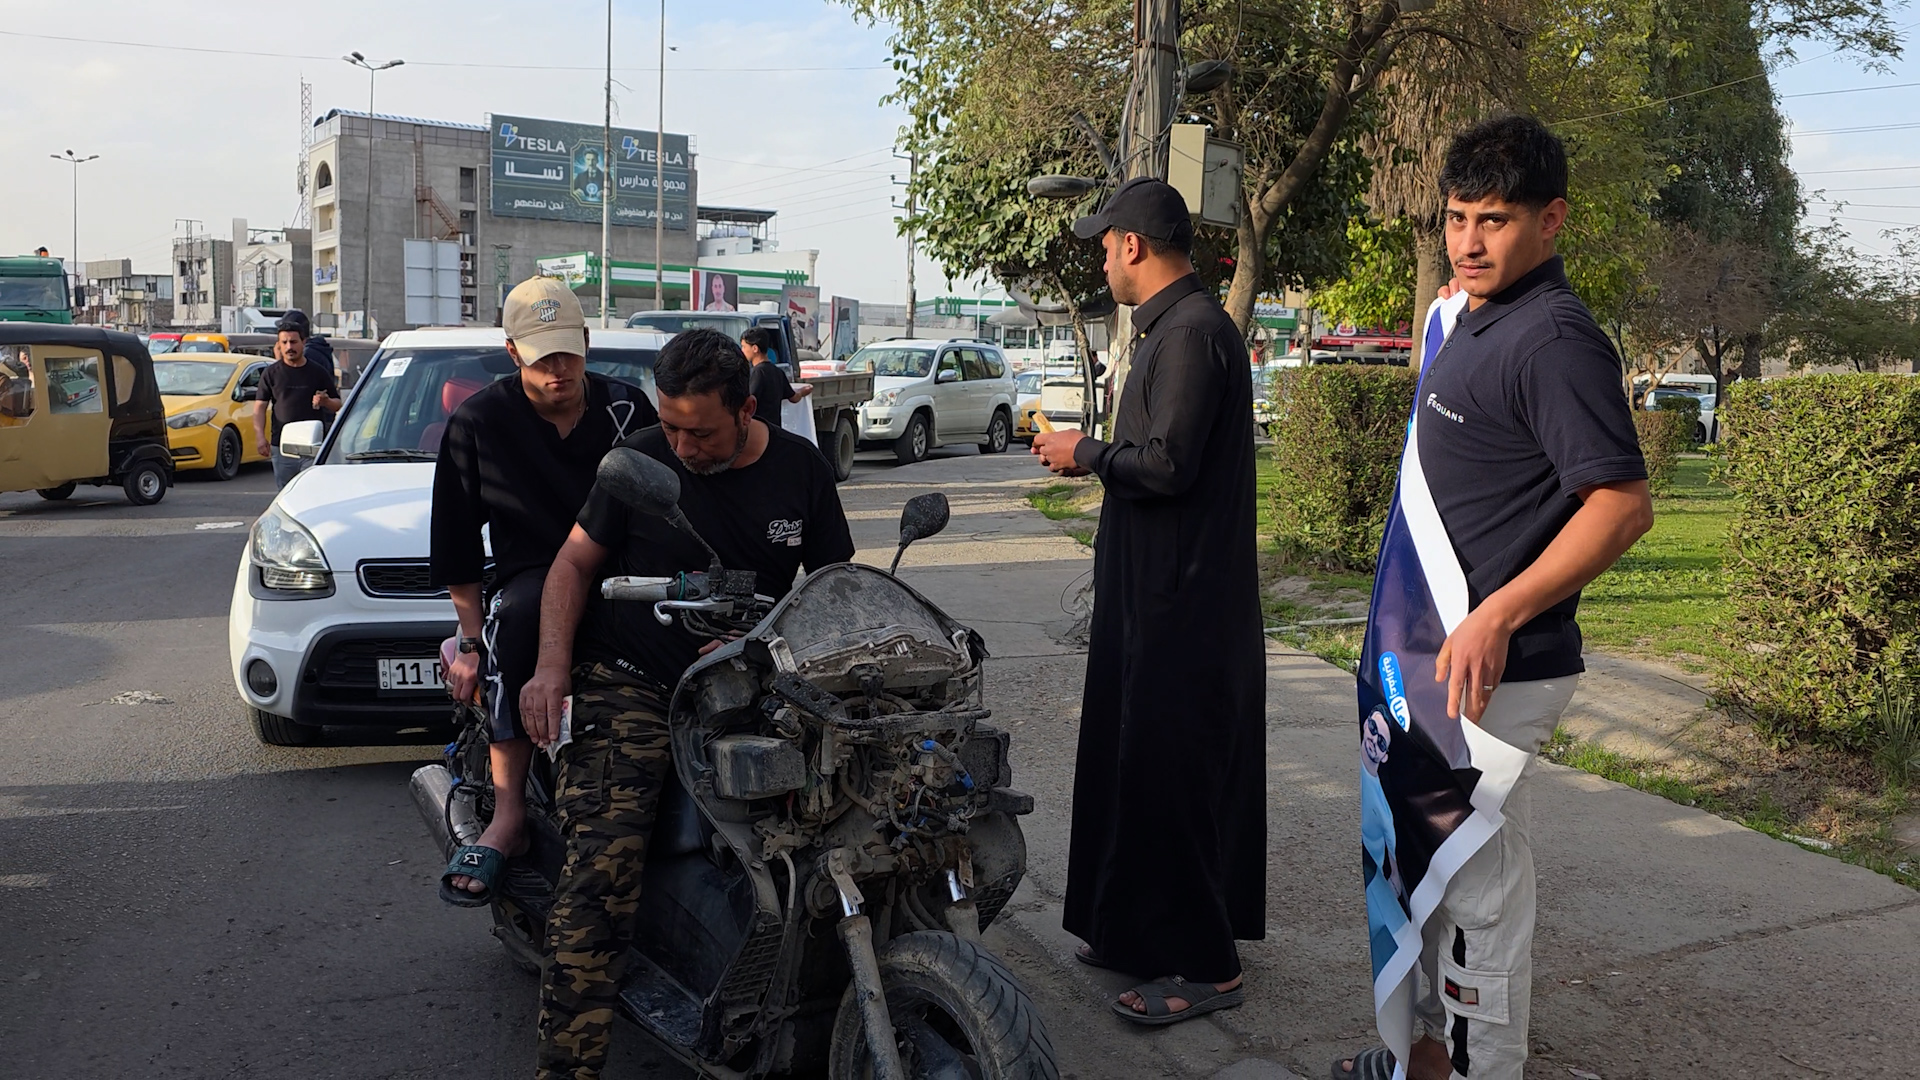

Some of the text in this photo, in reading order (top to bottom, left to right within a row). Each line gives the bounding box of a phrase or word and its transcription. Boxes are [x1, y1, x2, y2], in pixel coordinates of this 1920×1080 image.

[518, 136, 566, 153] TESLA
[505, 160, 563, 181] تسلا
[619, 174, 686, 192] مجموة مدارس
[548, 201, 564, 211] نحن
[670, 212, 683, 221] نحن
[396, 663, 423, 685] 11
